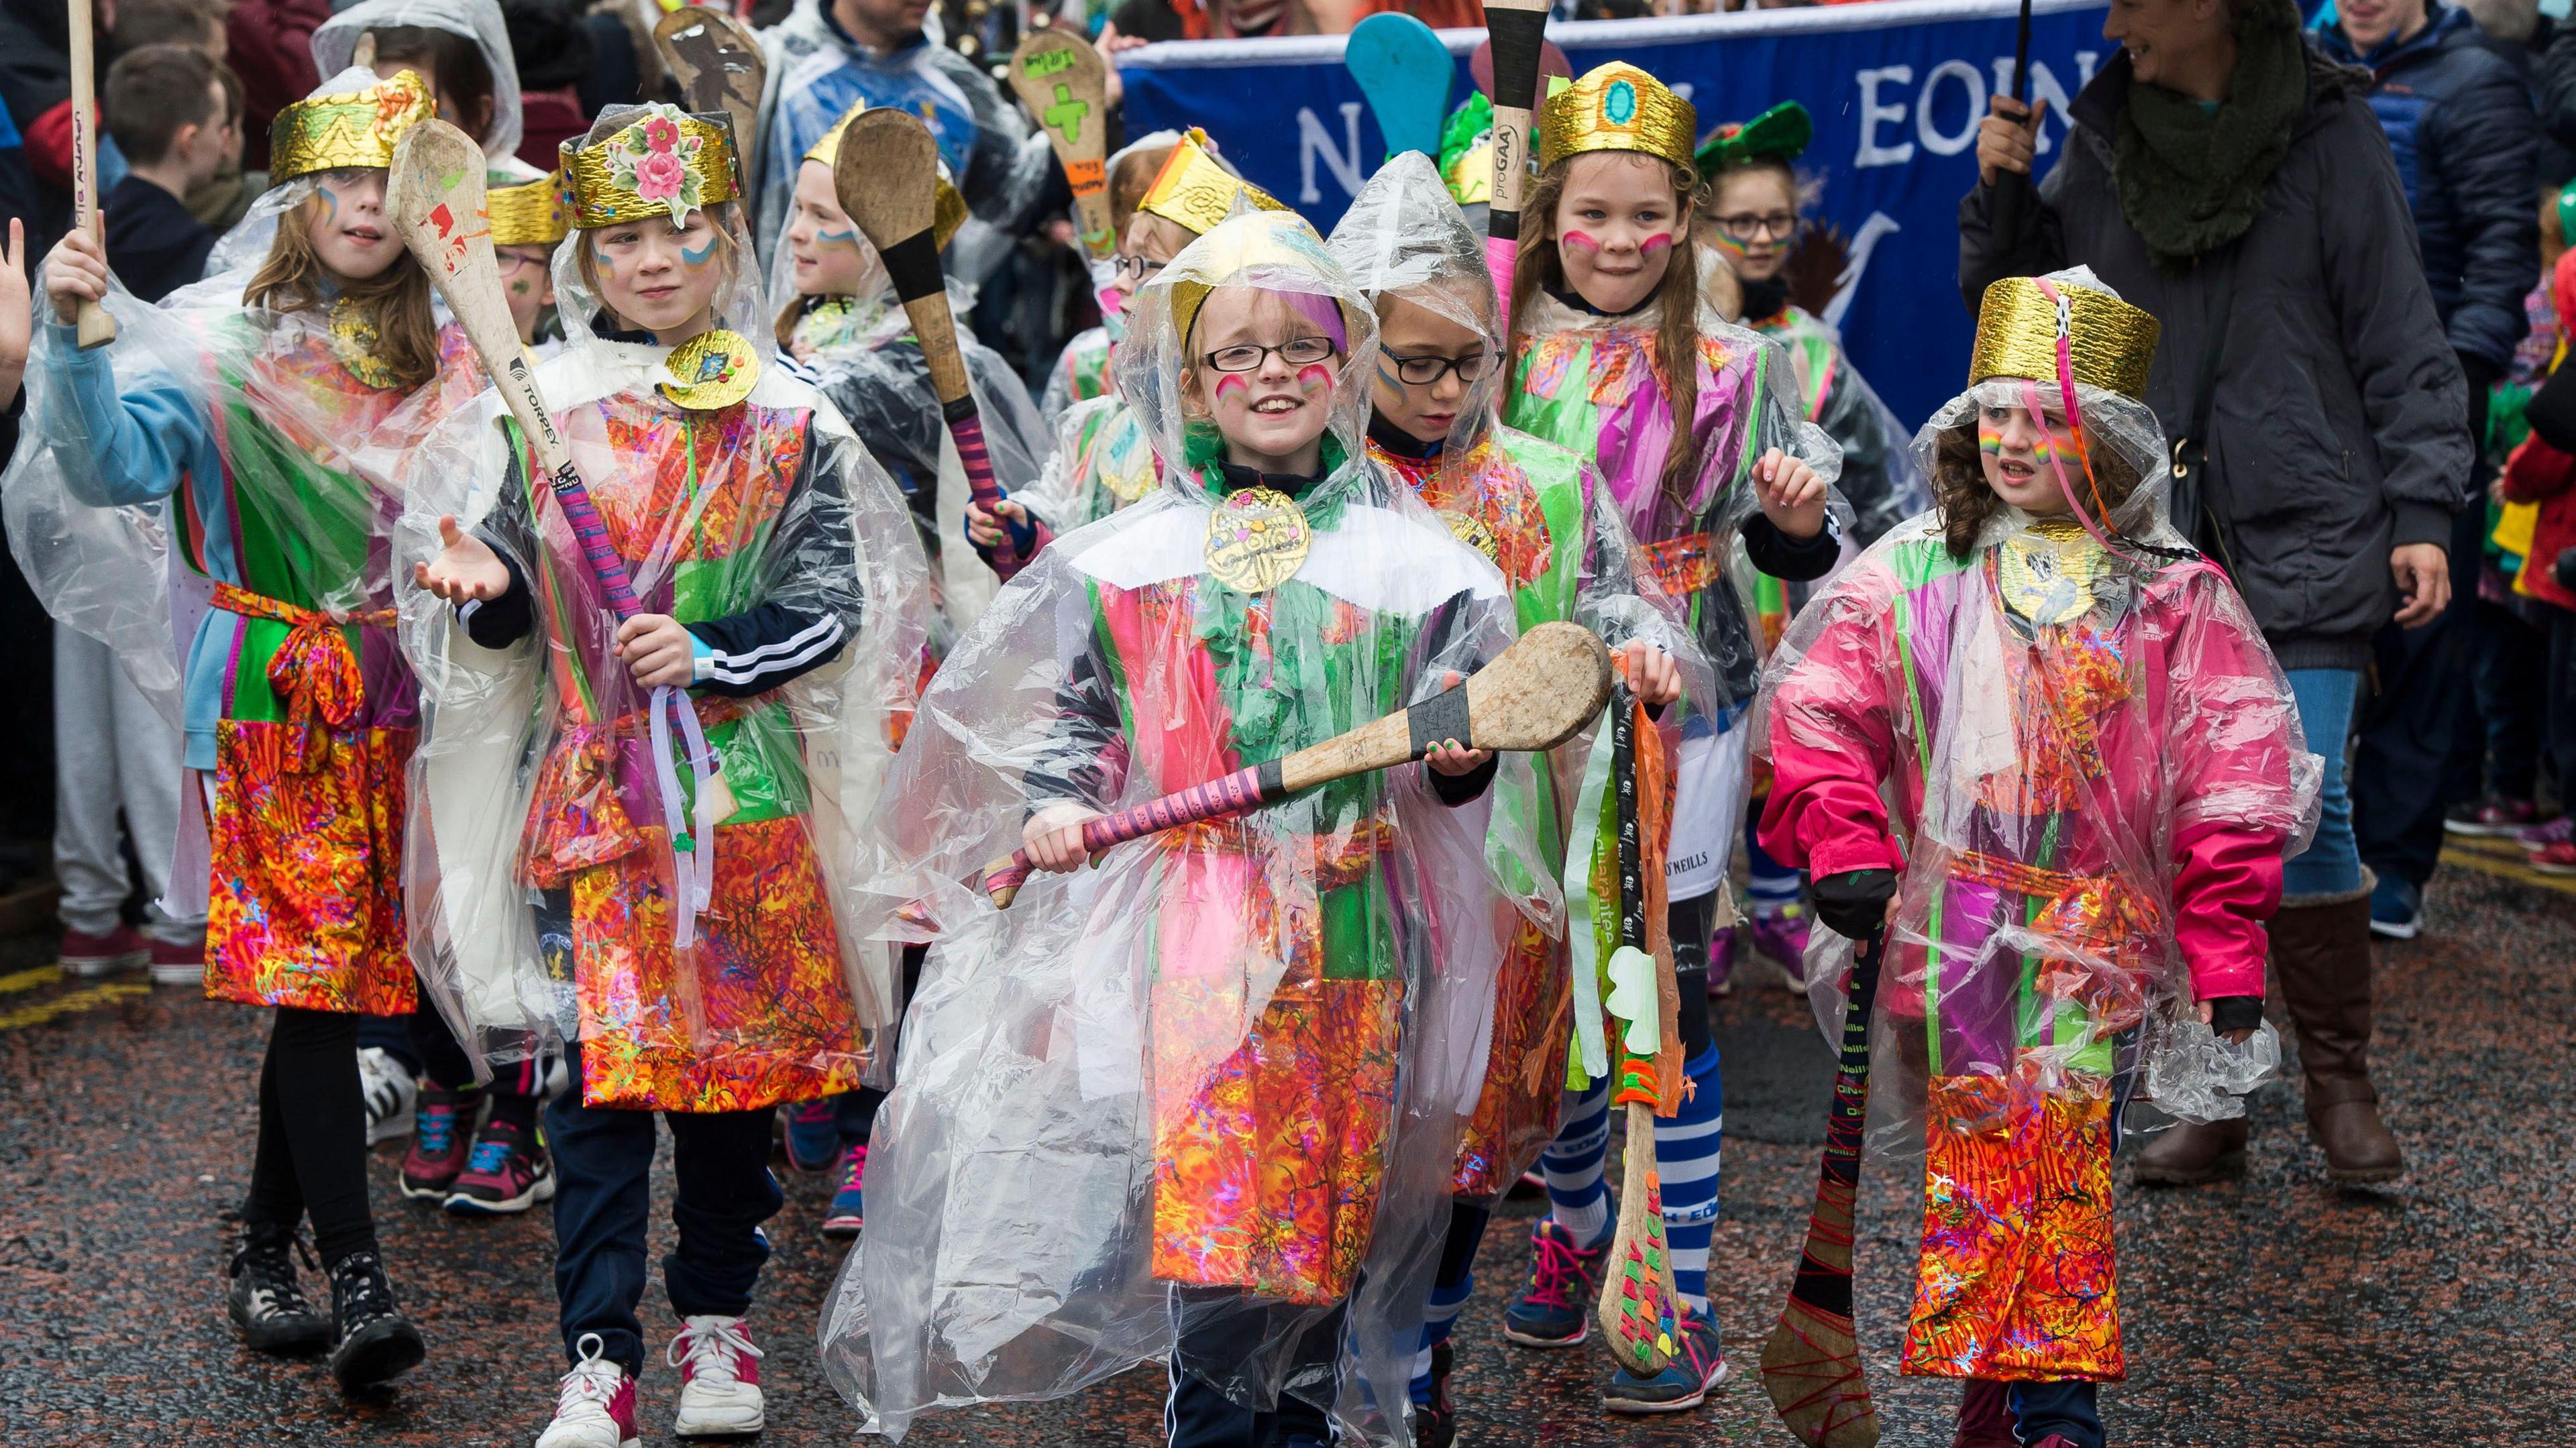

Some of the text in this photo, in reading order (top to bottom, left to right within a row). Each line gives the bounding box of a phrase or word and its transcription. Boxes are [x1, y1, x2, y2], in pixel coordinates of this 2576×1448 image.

[1496, 130, 1511, 199] proGAA
[524, 384, 560, 448] TORPEY
[1664, 850, 1708, 877] O'NEILLS
[1620, 1239, 1644, 1343] HAPPY
